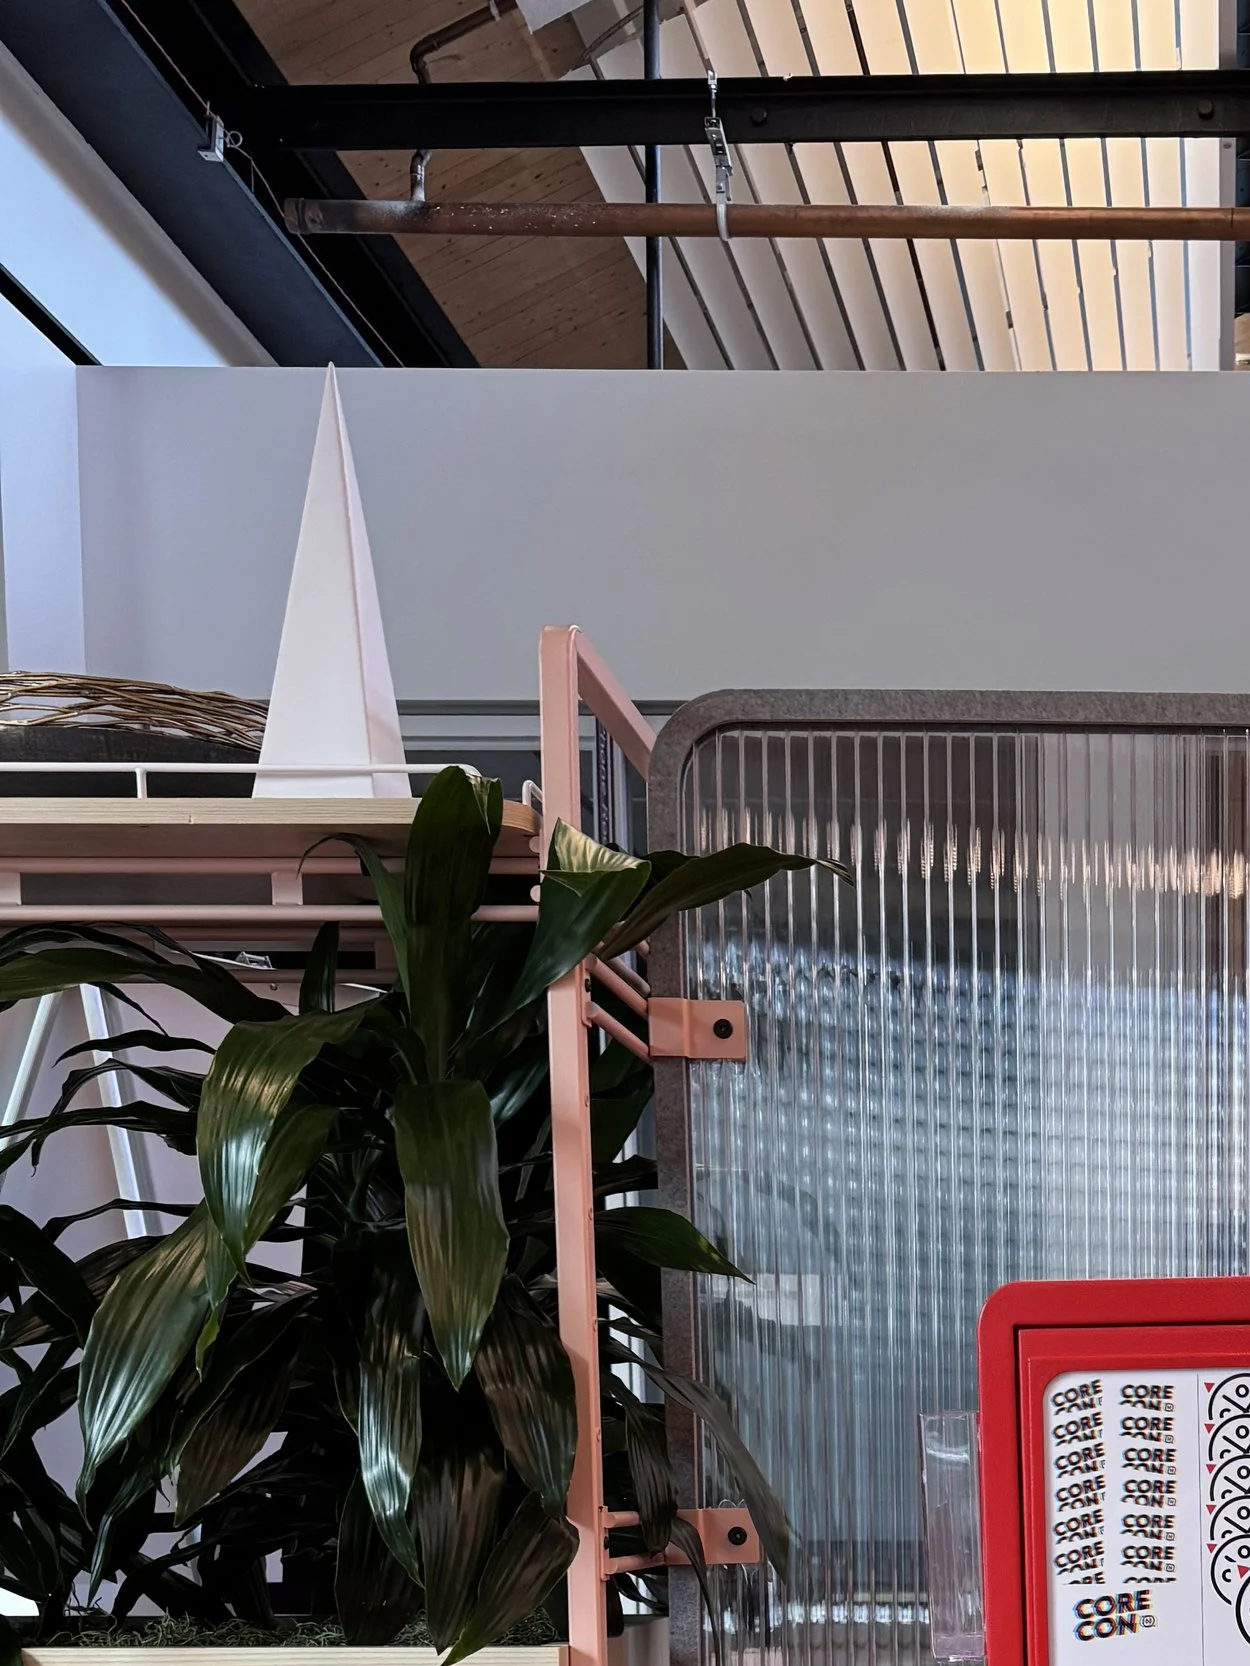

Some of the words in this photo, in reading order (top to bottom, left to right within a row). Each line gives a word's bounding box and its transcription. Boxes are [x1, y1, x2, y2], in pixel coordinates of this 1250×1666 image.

[1052, 1379, 1103, 1407] CORE
[1121, 1384, 1174, 1399] CORE
[1053, 1412, 1103, 1439] CORE
[1121, 1416, 1174, 1431] CORE
[1055, 1443, 1105, 1470] CORE
[1124, 1448, 1176, 1462] CORE
[1055, 1475, 1106, 1502] CORE
[1124, 1479, 1176, 1494] CORE
[1054, 1509, 1104, 1536] CORE
[1122, 1514, 1175, 1528] CORE
[1054, 1541, 1104, 1568] CORE
[1122, 1545, 1175, 1560] CORE
[1073, 1589, 1151, 1620] CORE
[1073, 1613, 1139, 1641] CON
